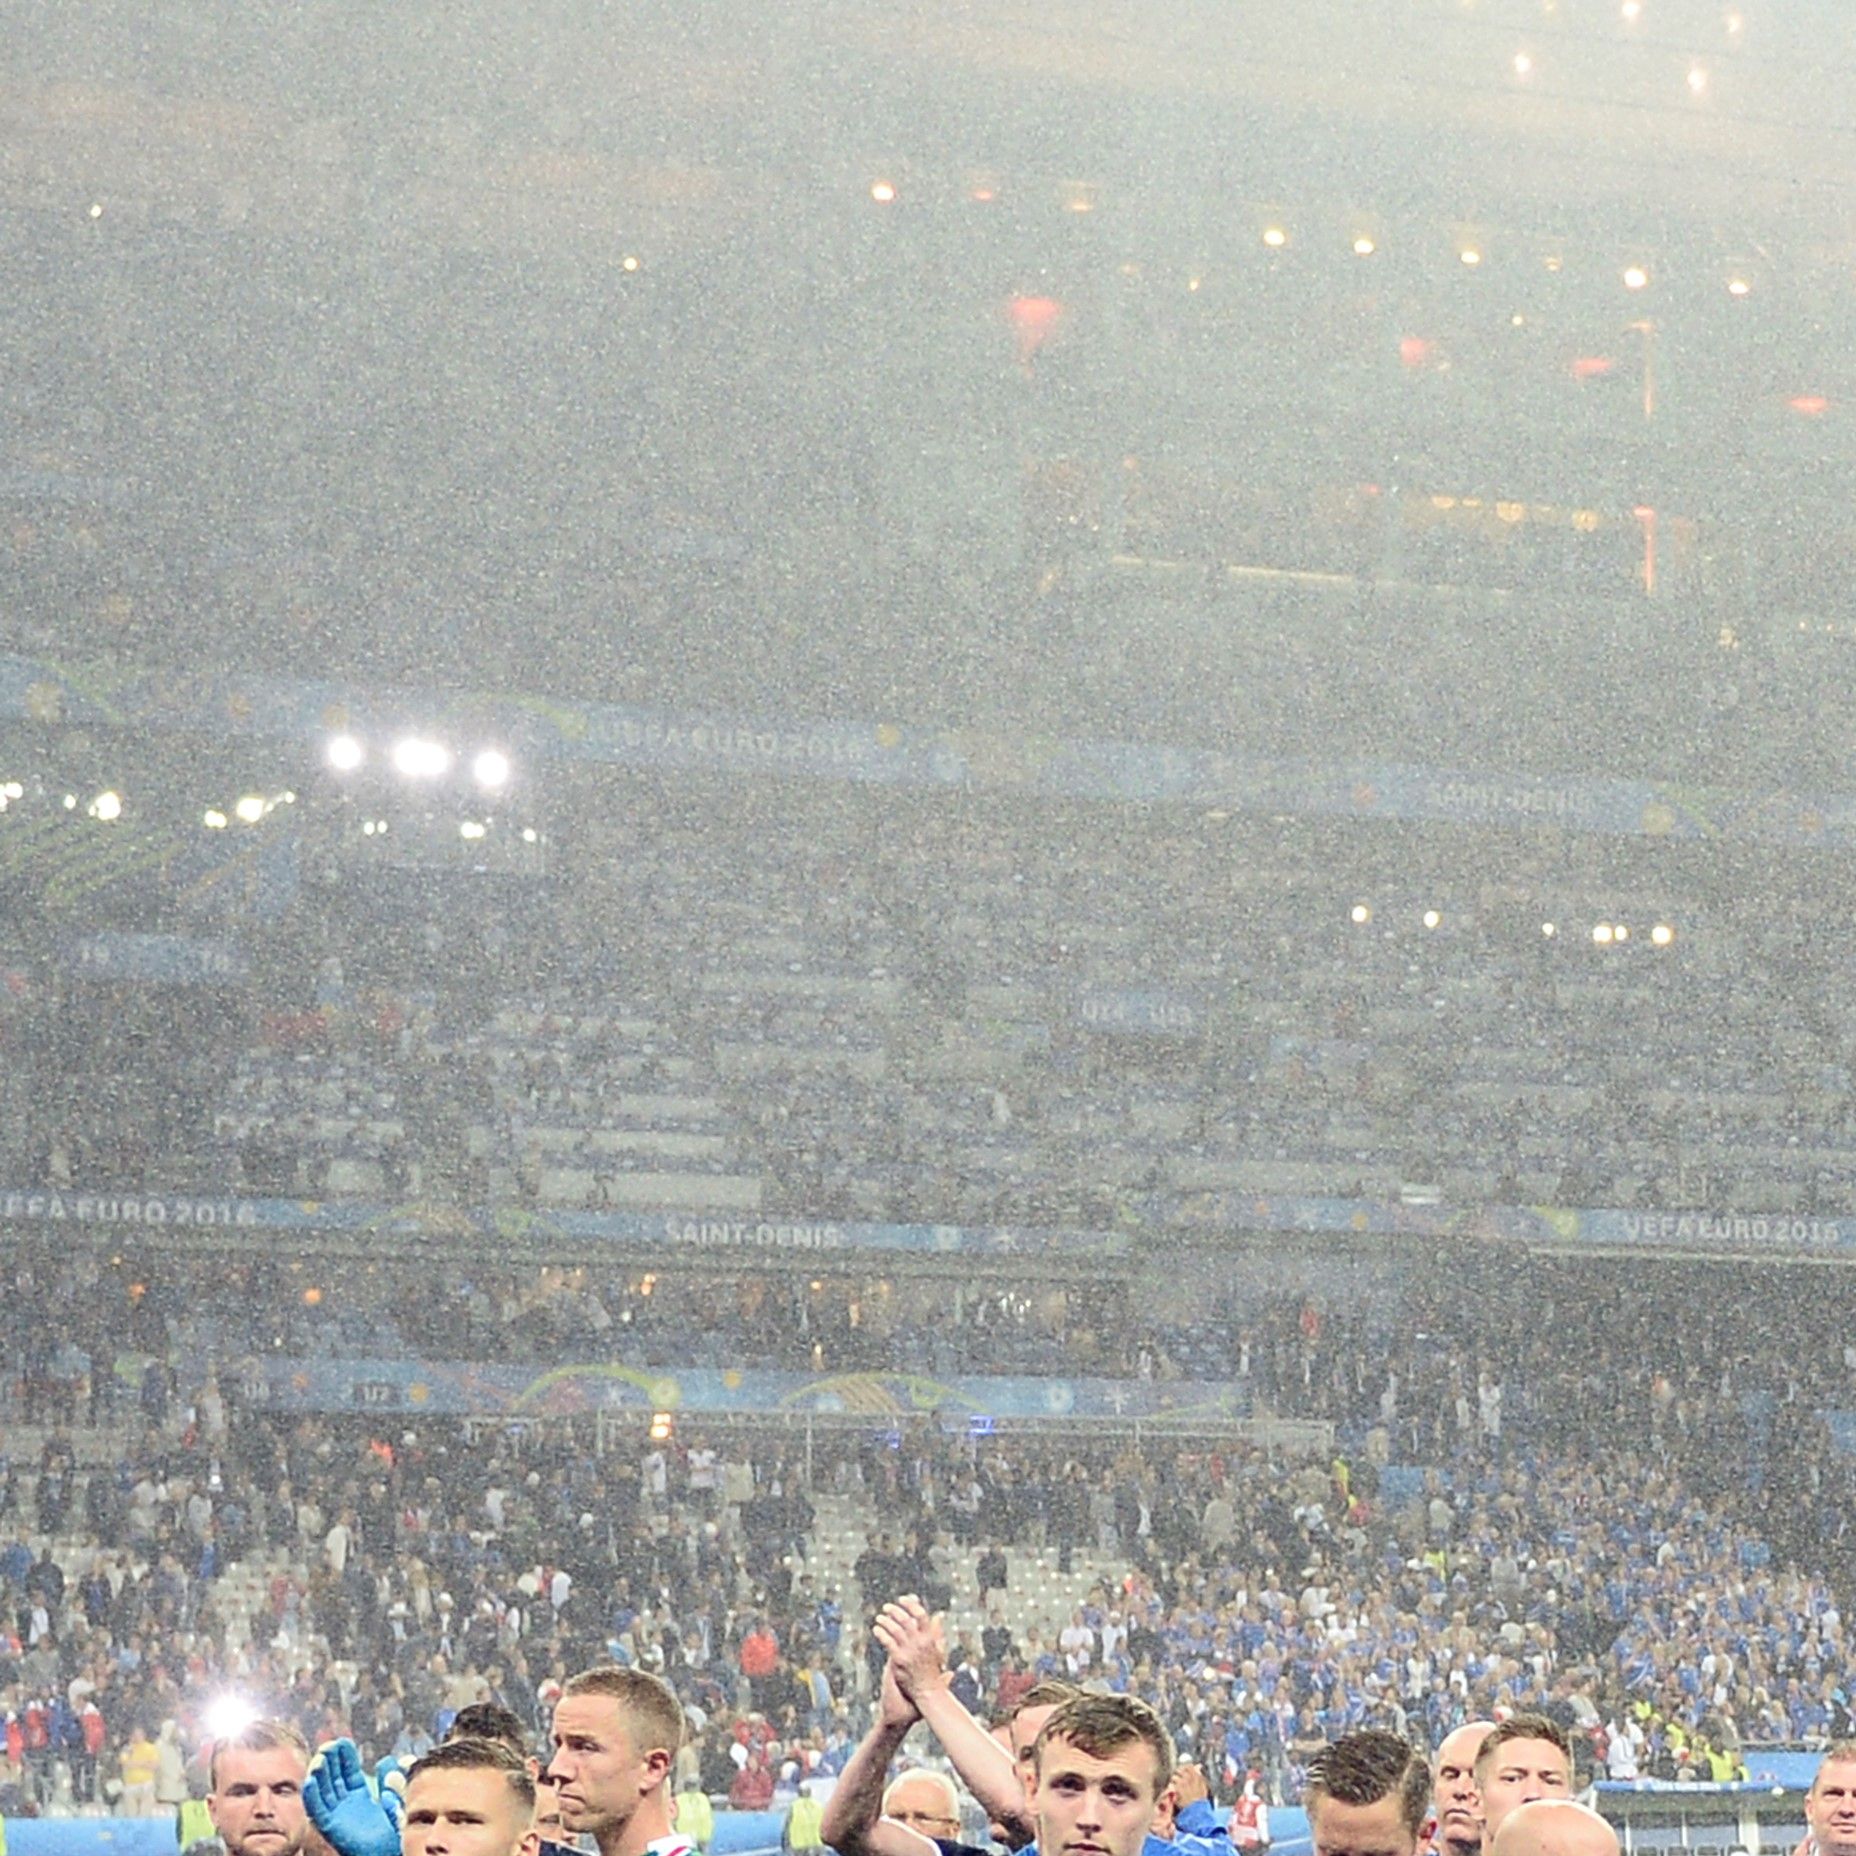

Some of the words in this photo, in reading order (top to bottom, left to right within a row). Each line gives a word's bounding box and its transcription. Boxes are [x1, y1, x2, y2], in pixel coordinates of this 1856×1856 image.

[77, 1199, 166, 1224] EURO
[176, 1203, 256, 1226] 2016
[665, 1219, 840, 1249] SAINT-DENIS
[1624, 1214, 1692, 1238] UEFA
[1699, 1217, 1768, 1241] EURO
[1776, 1220, 1839, 1244] 2016
